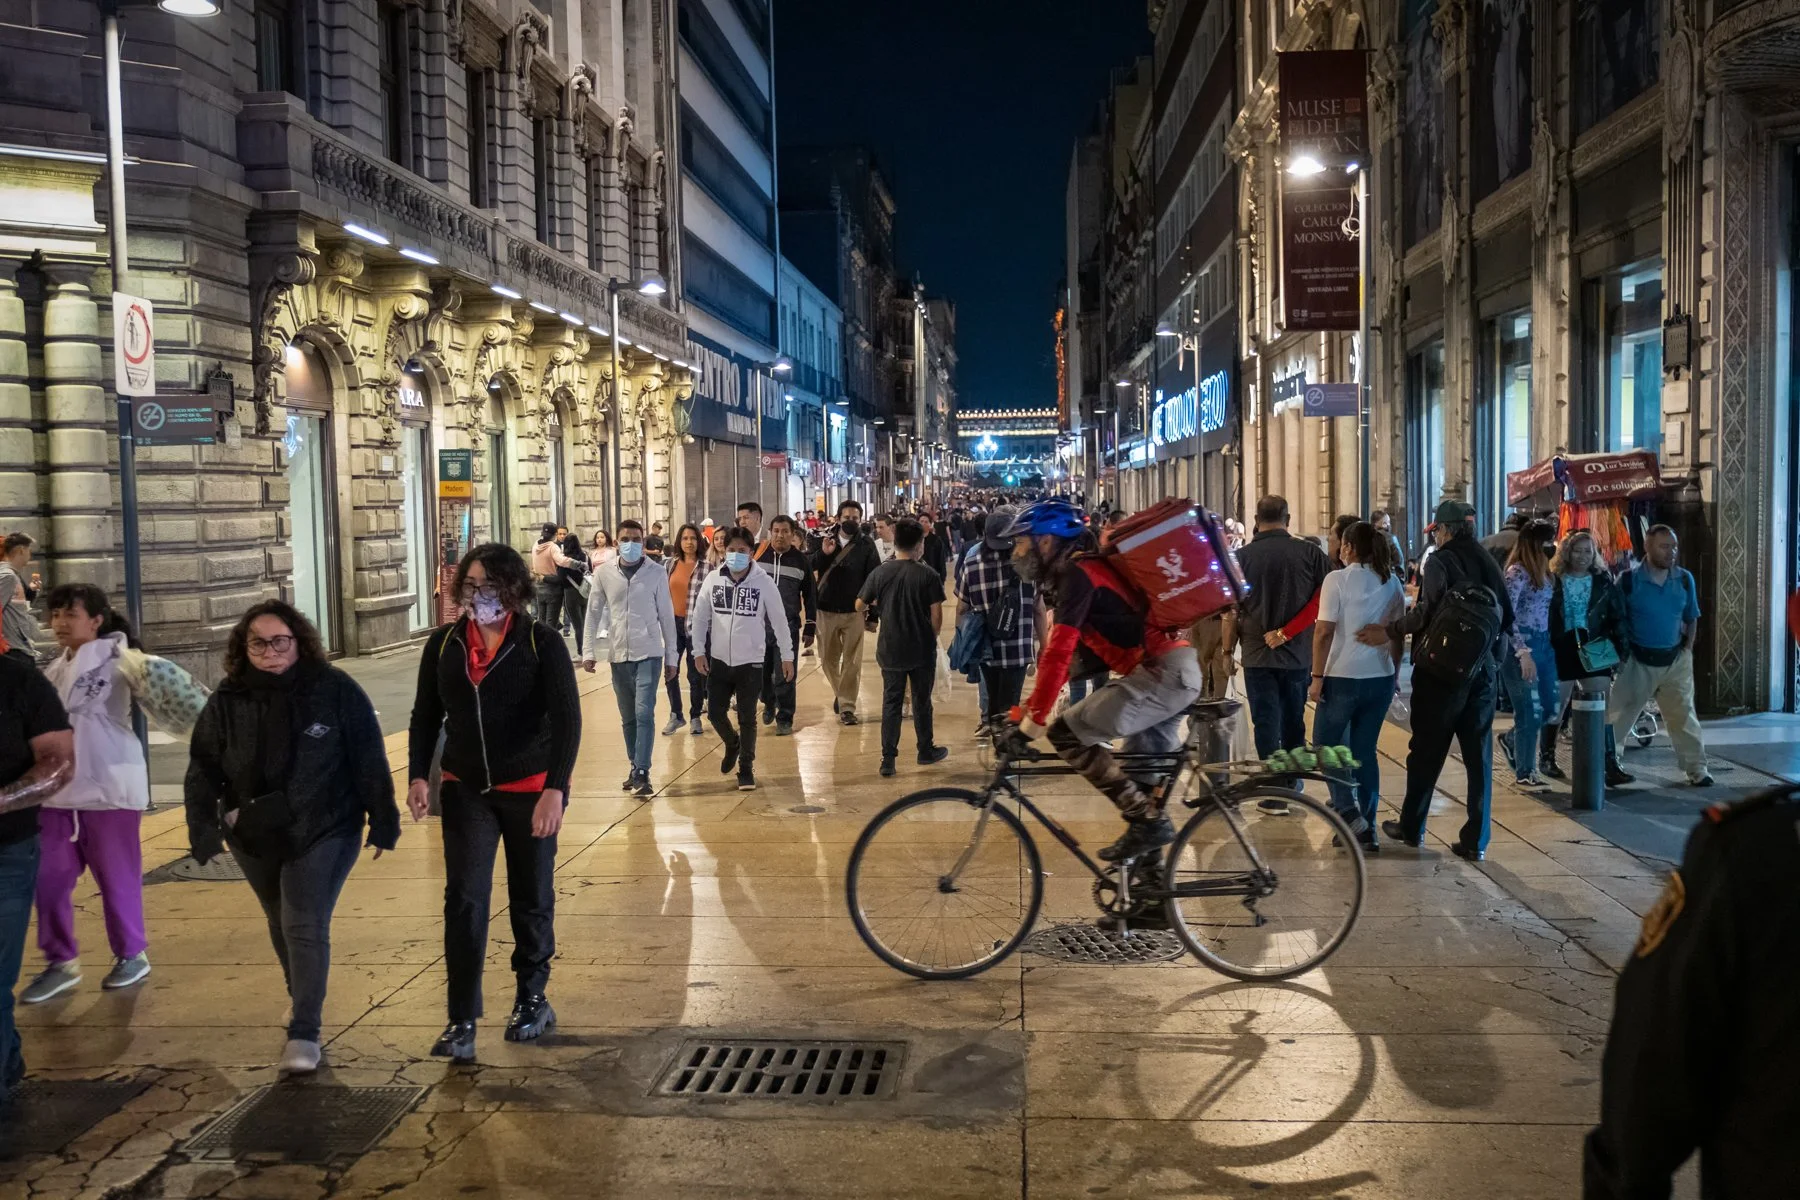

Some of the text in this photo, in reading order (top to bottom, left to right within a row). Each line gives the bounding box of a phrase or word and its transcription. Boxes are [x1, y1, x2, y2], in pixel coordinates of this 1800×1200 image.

[1302, 216, 1347, 228] CARLO
[1293, 230, 1358, 244] MONSIV
[398, 388, 425, 407] ARA
[548, 413, 560, 425] RA
